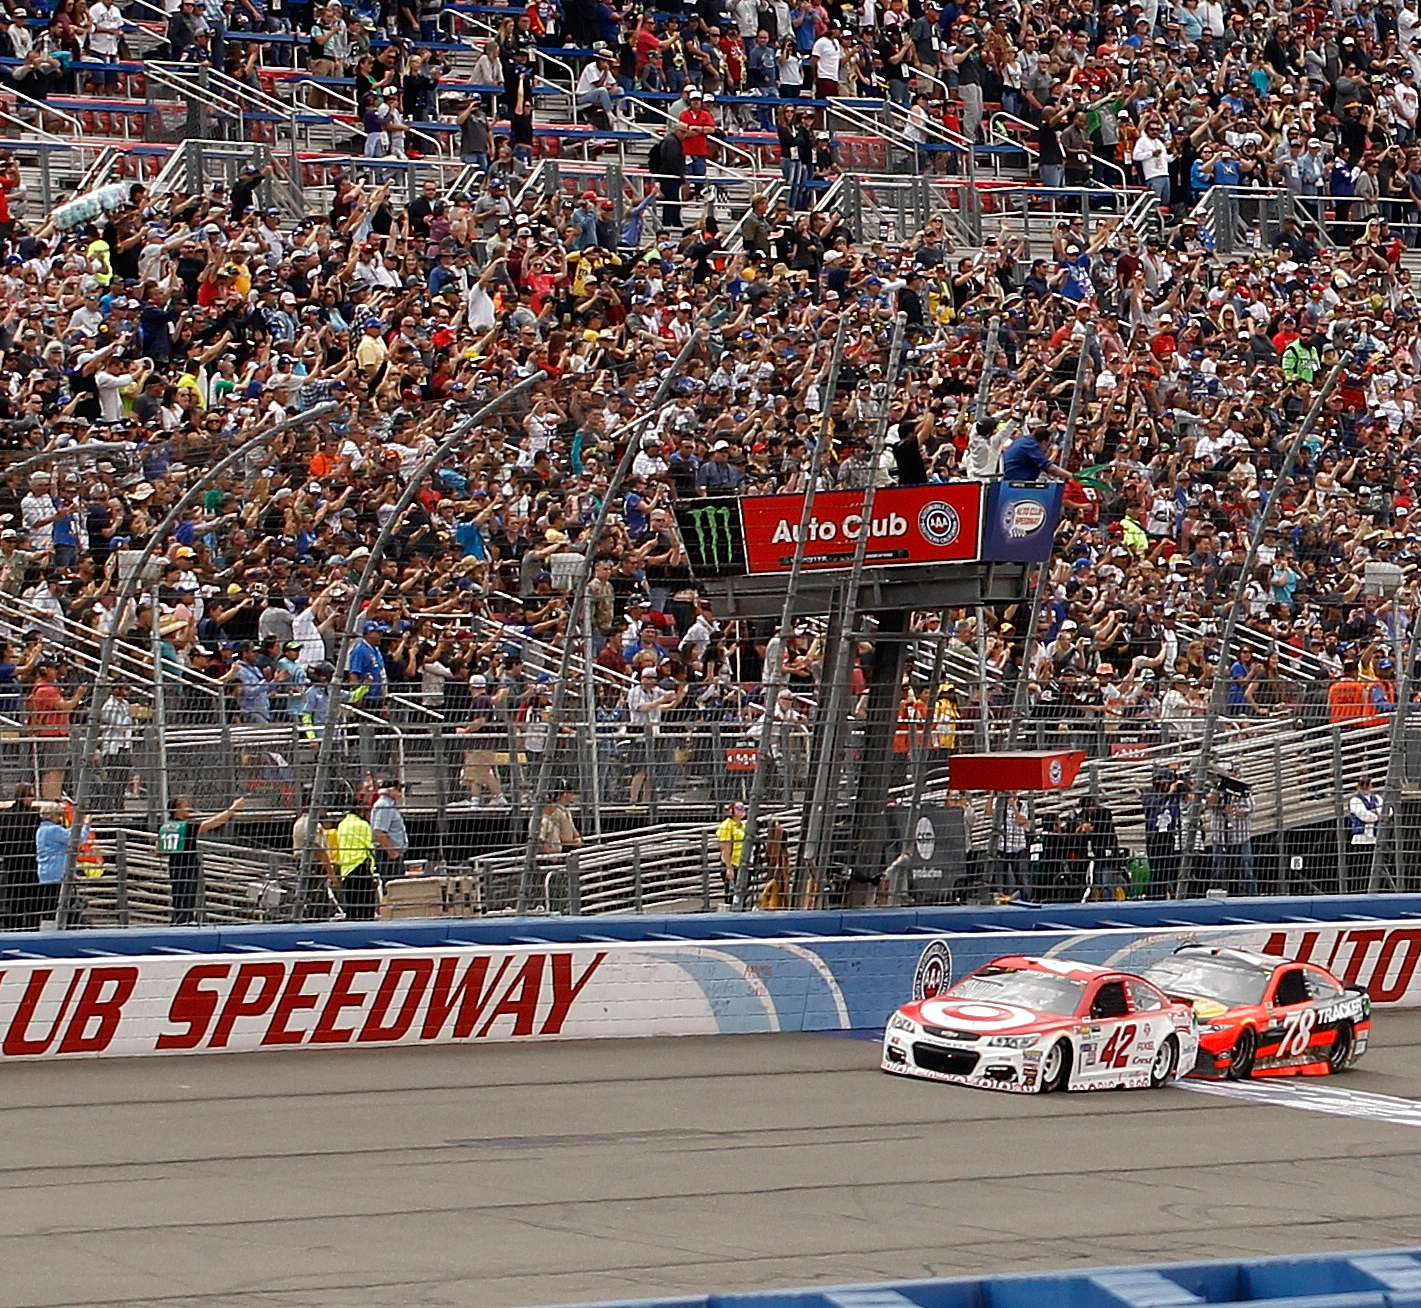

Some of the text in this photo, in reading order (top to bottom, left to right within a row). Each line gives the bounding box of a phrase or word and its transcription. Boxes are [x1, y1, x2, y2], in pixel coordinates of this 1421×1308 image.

[772, 512, 908, 544] Auto Cub
[930, 516, 948, 529] AAA
[161, 833, 180, 850] 117
[0, 952, 608, 1056] UB SPEEDWAY
[1318, 998, 1363, 1024] TRACKER
[1100, 1024, 1137, 1068] 42
[1276, 1009, 1315, 1058] 78
[1132, 1056, 1153, 1065] Crest
